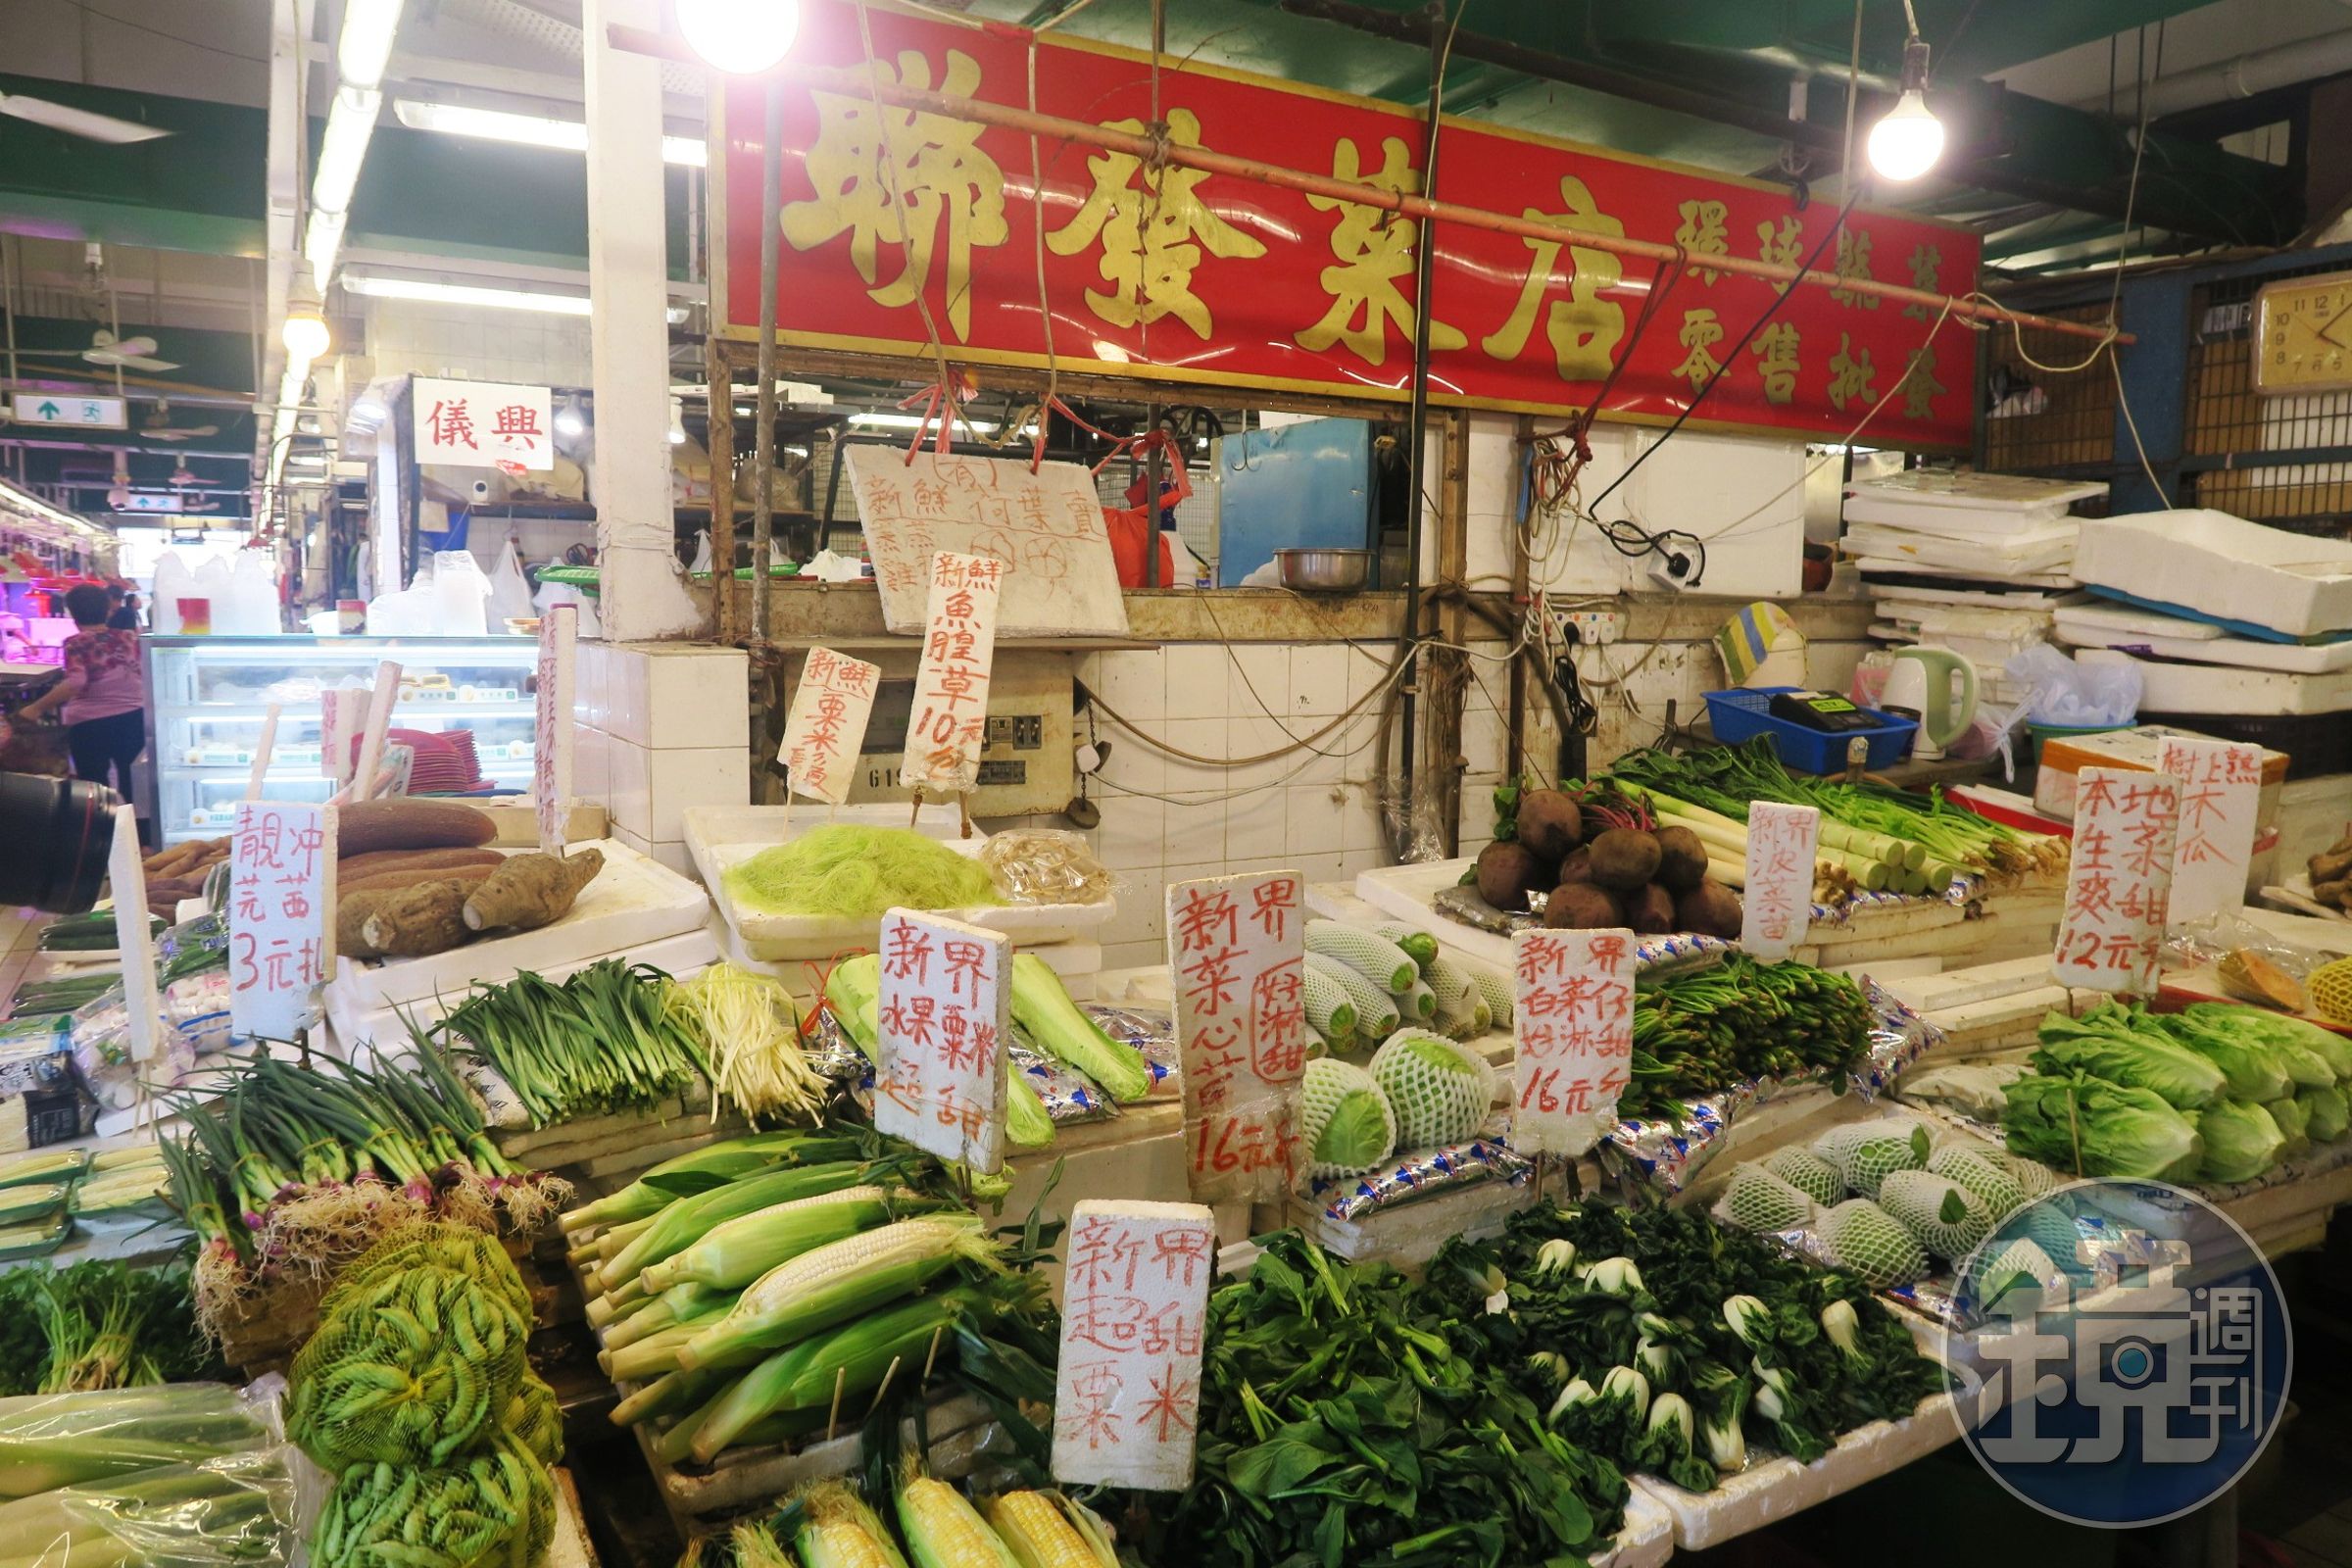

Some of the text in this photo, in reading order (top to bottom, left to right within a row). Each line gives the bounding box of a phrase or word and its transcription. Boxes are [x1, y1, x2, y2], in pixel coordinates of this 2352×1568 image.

[2276, 313, 2290, 326] 10
[2315, 295, 2328, 309] 12
[1671, 308, 1947, 419] 零售批發
[425, 398, 542, 450] 儀興
[935, 553, 1002, 593] 新鮮
[808, 649, 873, 697] 新鮮
[2079, 774, 2180, 819] 本地
[1750, 806, 1813, 851] 新界
[2077, 820, 2179, 878] 生菜
[1177, 879, 1296, 951] 新界
[884, 916, 991, 1011] 新界
[1518, 935, 1627, 985] 新界
[1520, 975, 1632, 1022] 白菜仔
[1071, 1215, 1214, 1291] 新界
